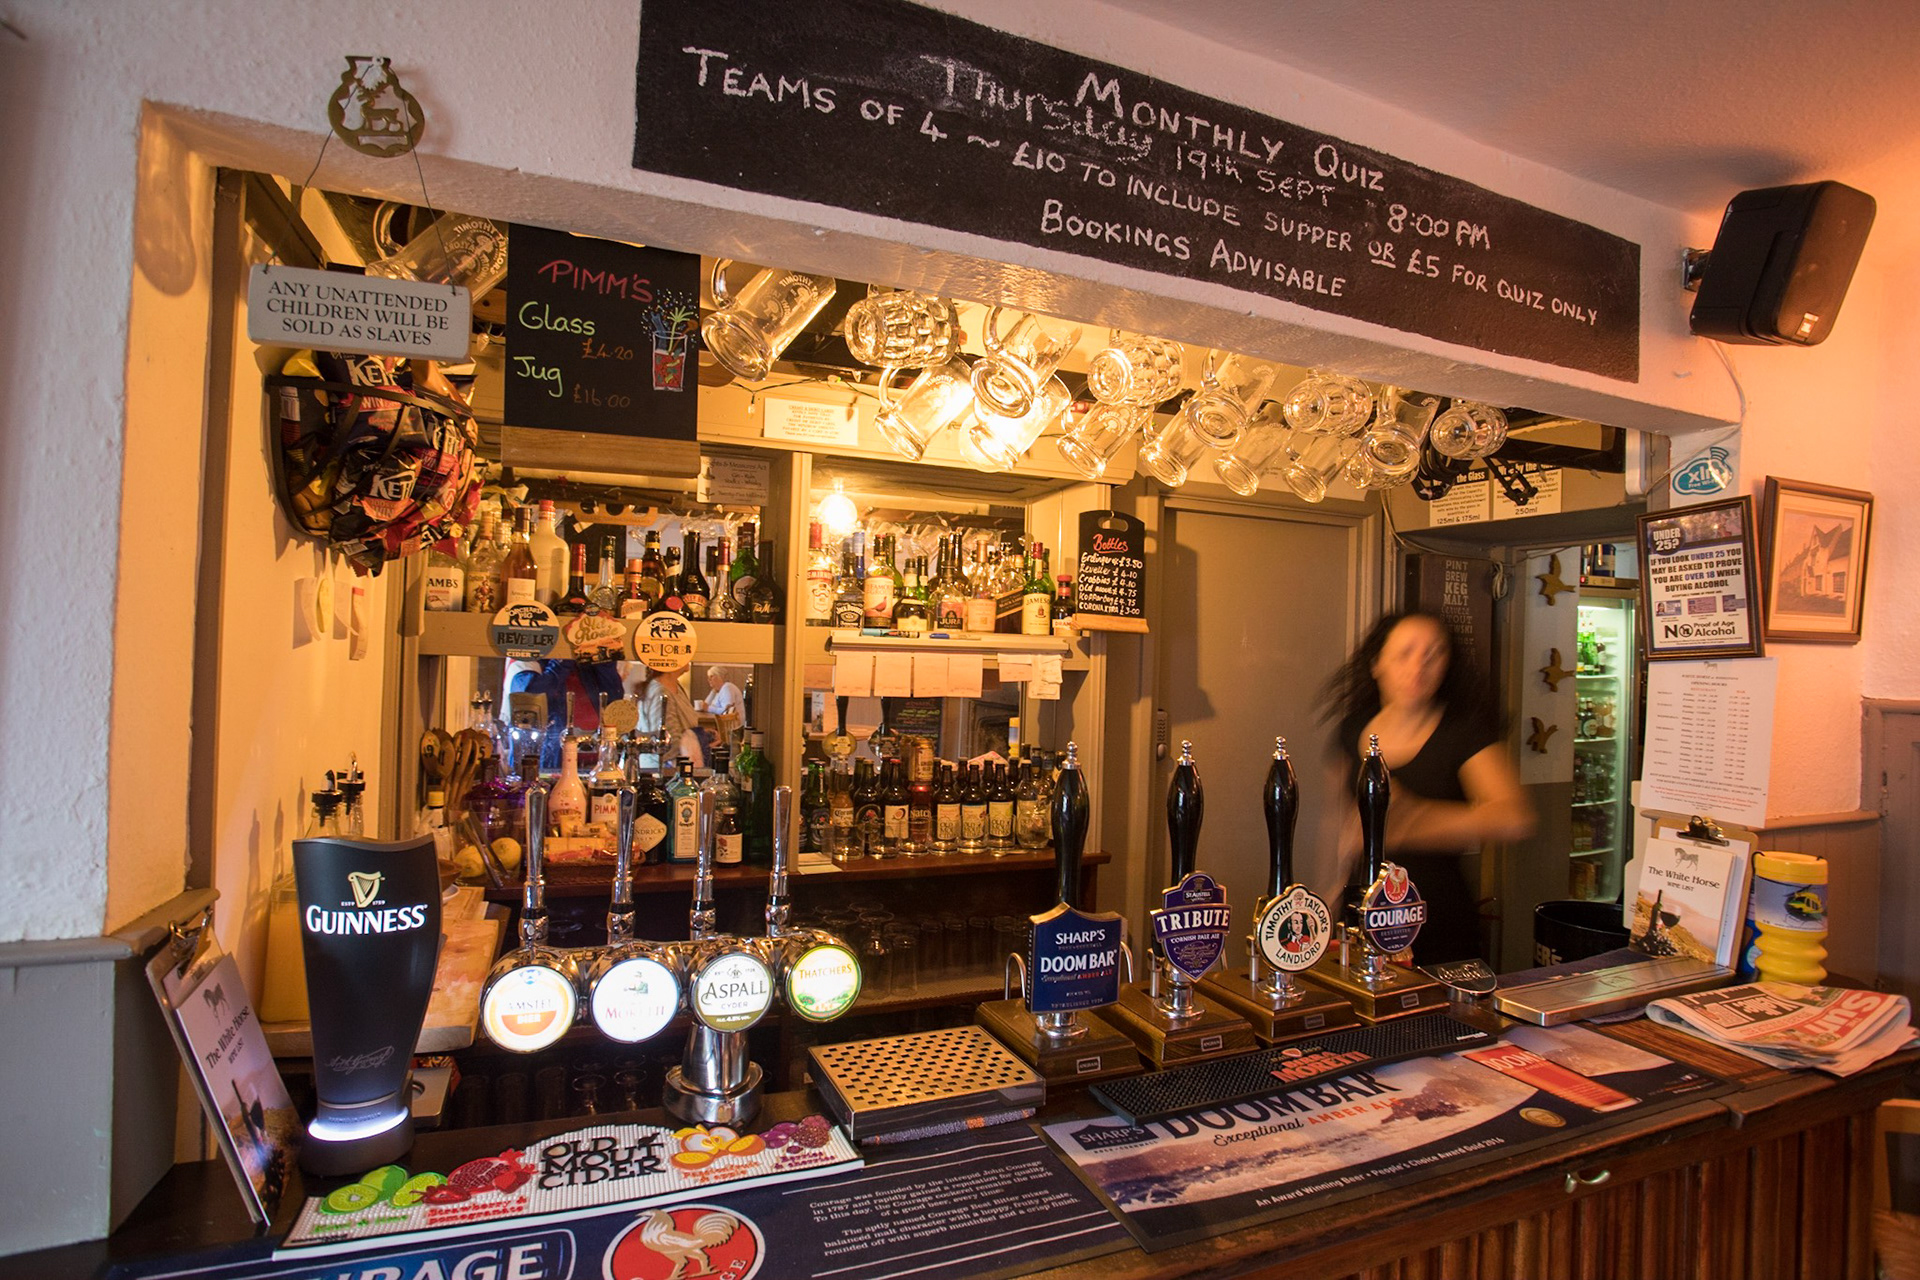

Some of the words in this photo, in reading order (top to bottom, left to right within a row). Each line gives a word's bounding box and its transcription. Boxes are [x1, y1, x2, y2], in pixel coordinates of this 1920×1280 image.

[1075, 72, 1284, 164] MONTHLY
[1314, 144, 1384, 191] QUIZ
[682, 46, 837, 113] TEAMS
[861, 100, 903, 125] OF
[920, 111, 947, 141] 4
[1012, 141, 1065, 173] £10
[1081, 162, 1115, 186] TO
[1127, 175, 1241, 226] INCLUDE
[1264, 211, 1352, 252] SUPPER
[1368, 242, 1397, 266] OR
[1407, 253, 1440, 278] £5
[1452, 264, 1488, 293] FOR
[1497, 281, 1545, 311] QUIZ
[1551, 297, 1598, 326] ONLY
[1176, 145, 1242, 183] 19th
[1456, 224, 1491, 249] PM
[453, 221, 497, 234] TIMOTHY
[1041, 199, 1192, 260] BOOKINGS
[1210, 239, 1347, 297] ADVISABLE
[538, 260, 653, 302] PIMM'S
[268, 282, 310, 297] ANY
[317, 286, 448, 312] UNATTENDED
[267, 298, 369, 321] CHILDREN
[375, 310, 421, 327] WILL
[427, 315, 449, 330] BE
[519, 301, 595, 335] Glass
[282, 318, 333, 335] SOLD
[339, 325, 361, 338] AS
[368, 327, 431, 345] SLAVES
[514, 357, 563, 397] Jug
[1457, 474, 1467, 483] the
[1468, 472, 1485, 481] Glass
[1525, 463, 1537, 471] the
[1515, 507, 1538, 515] 250ml
[1093, 534, 1128, 552] Bottles
[1653, 528, 1680, 540] UNDER
[1656, 539, 1679, 551] 25?
[1446, 561, 1468, 570] PINT
[1652, 567, 1666, 575] MAY
[1668, 565, 1677, 573] BE
[1679, 563, 1703, 572] ASKED
[1716, 558, 1742, 568] PROVE
[1658, 556, 1670, 565] YOU
[1672, 555, 1689, 564] LOOK
[1691, 552, 1714, 561] UNDER
[1715, 550, 1725, 558] 25
[1726, 548, 1741, 557] YOU
[1446, 571, 1468, 581] BREW
[1653, 576, 1668, 584] YOU
[1669, 574, 1684, 582] ARE
[1685, 572, 1704, 581] OVER
[1717, 568, 1741, 577] WHEN
[1665, 583, 1692, 592] BUYING
[1694, 579, 1729, 590] ALCOHOL
[1445, 582, 1468, 594] KEG
[1444, 594, 1469, 606] MALT
[1695, 627, 1735, 637] Alcohol
[1648, 866, 1663, 876] The
[1665, 870, 1690, 882] White
[1692, 876, 1720, 889] Horse
[306, 904, 426, 935] GUINNESS
[1157, 909, 1230, 932] TRIBUTE
[1265, 899, 1293, 941] TIMOTHY
[1304, 897, 1328, 934] TAYLOR'S
[1369, 906, 1424, 927] COURAGE
[1055, 929, 1105, 945] SHARP'S
[1171, 934, 1196, 944] CORNISH
[1040, 954, 1088, 974] DOOM
[1089, 950, 1115, 969] BAR
[1275, 941, 1321, 964] LANDLORD
[799, 964, 852, 979] THATCHERS
[701, 981, 767, 1006] ASPALL
[1804, 992, 1882, 1035] Sun
[205, 1048, 221, 1069] The
[218, 1026, 235, 1051] White
[232, 1006, 249, 1031] Horse
[1271, 1051, 1373, 1083] MORETTI
[1282, 1052, 1341, 1068] BIRRA
[1157, 1090, 1312, 1139] DOOM
[1305, 1069, 1403, 1108] BAR
[1213, 1118, 1305, 1147] Exceptional
[1307, 1106, 1360, 1126] AMBER
[1368, 1097, 1405, 1111] ALE
[1079, 1125, 1145, 1144] SHARP'S
[541, 1136, 618, 1159] OLD
[541, 1142, 665, 1174] MOUT
[538, 1158, 666, 1191] CIDER
[810, 1197, 852, 1208] Courage
[875, 1185, 912, 1197] founded
[945, 1172, 980, 1182] intrepid
[983, 1168, 1005, 1176] John
[1006, 1160, 1042, 1171] Courage
[1255, 1196, 1270, 1208] An
[1271, 1188, 1303, 1204] Award
[1304, 1177, 1342, 1195] Winning
[1340, 1172, 1365, 1186] Beer
[1371, 1161, 1410, 1178] People's
[1410, 1154, 1439, 1168] Choice
[1438, 1147, 1465, 1161] Award
[830, 1212, 850, 1220] this
[892, 1196, 933, 1208] Courage
[935, 1188, 973, 1199] cockerel
[976, 1180, 1012, 1191] remains
[1030, 1171, 1053, 1180] mark
[873, 1194, 907, 1205] rapidly
[910, 1188, 941, 1198] gained
[952, 1176, 998, 1189] reputation
[428, 1201, 512, 1217] Strawberry
[429, 1206, 524, 1225] pomegranate
[842, 1228, 863, 1236] The
[865, 1222, 889, 1232] aptly
[893, 1215, 926, 1226] named
[928, 1207, 968, 1218] Courage
[970, 1201, 992, 1210] Best
[993, 1195, 1019, 1205] Bitter
